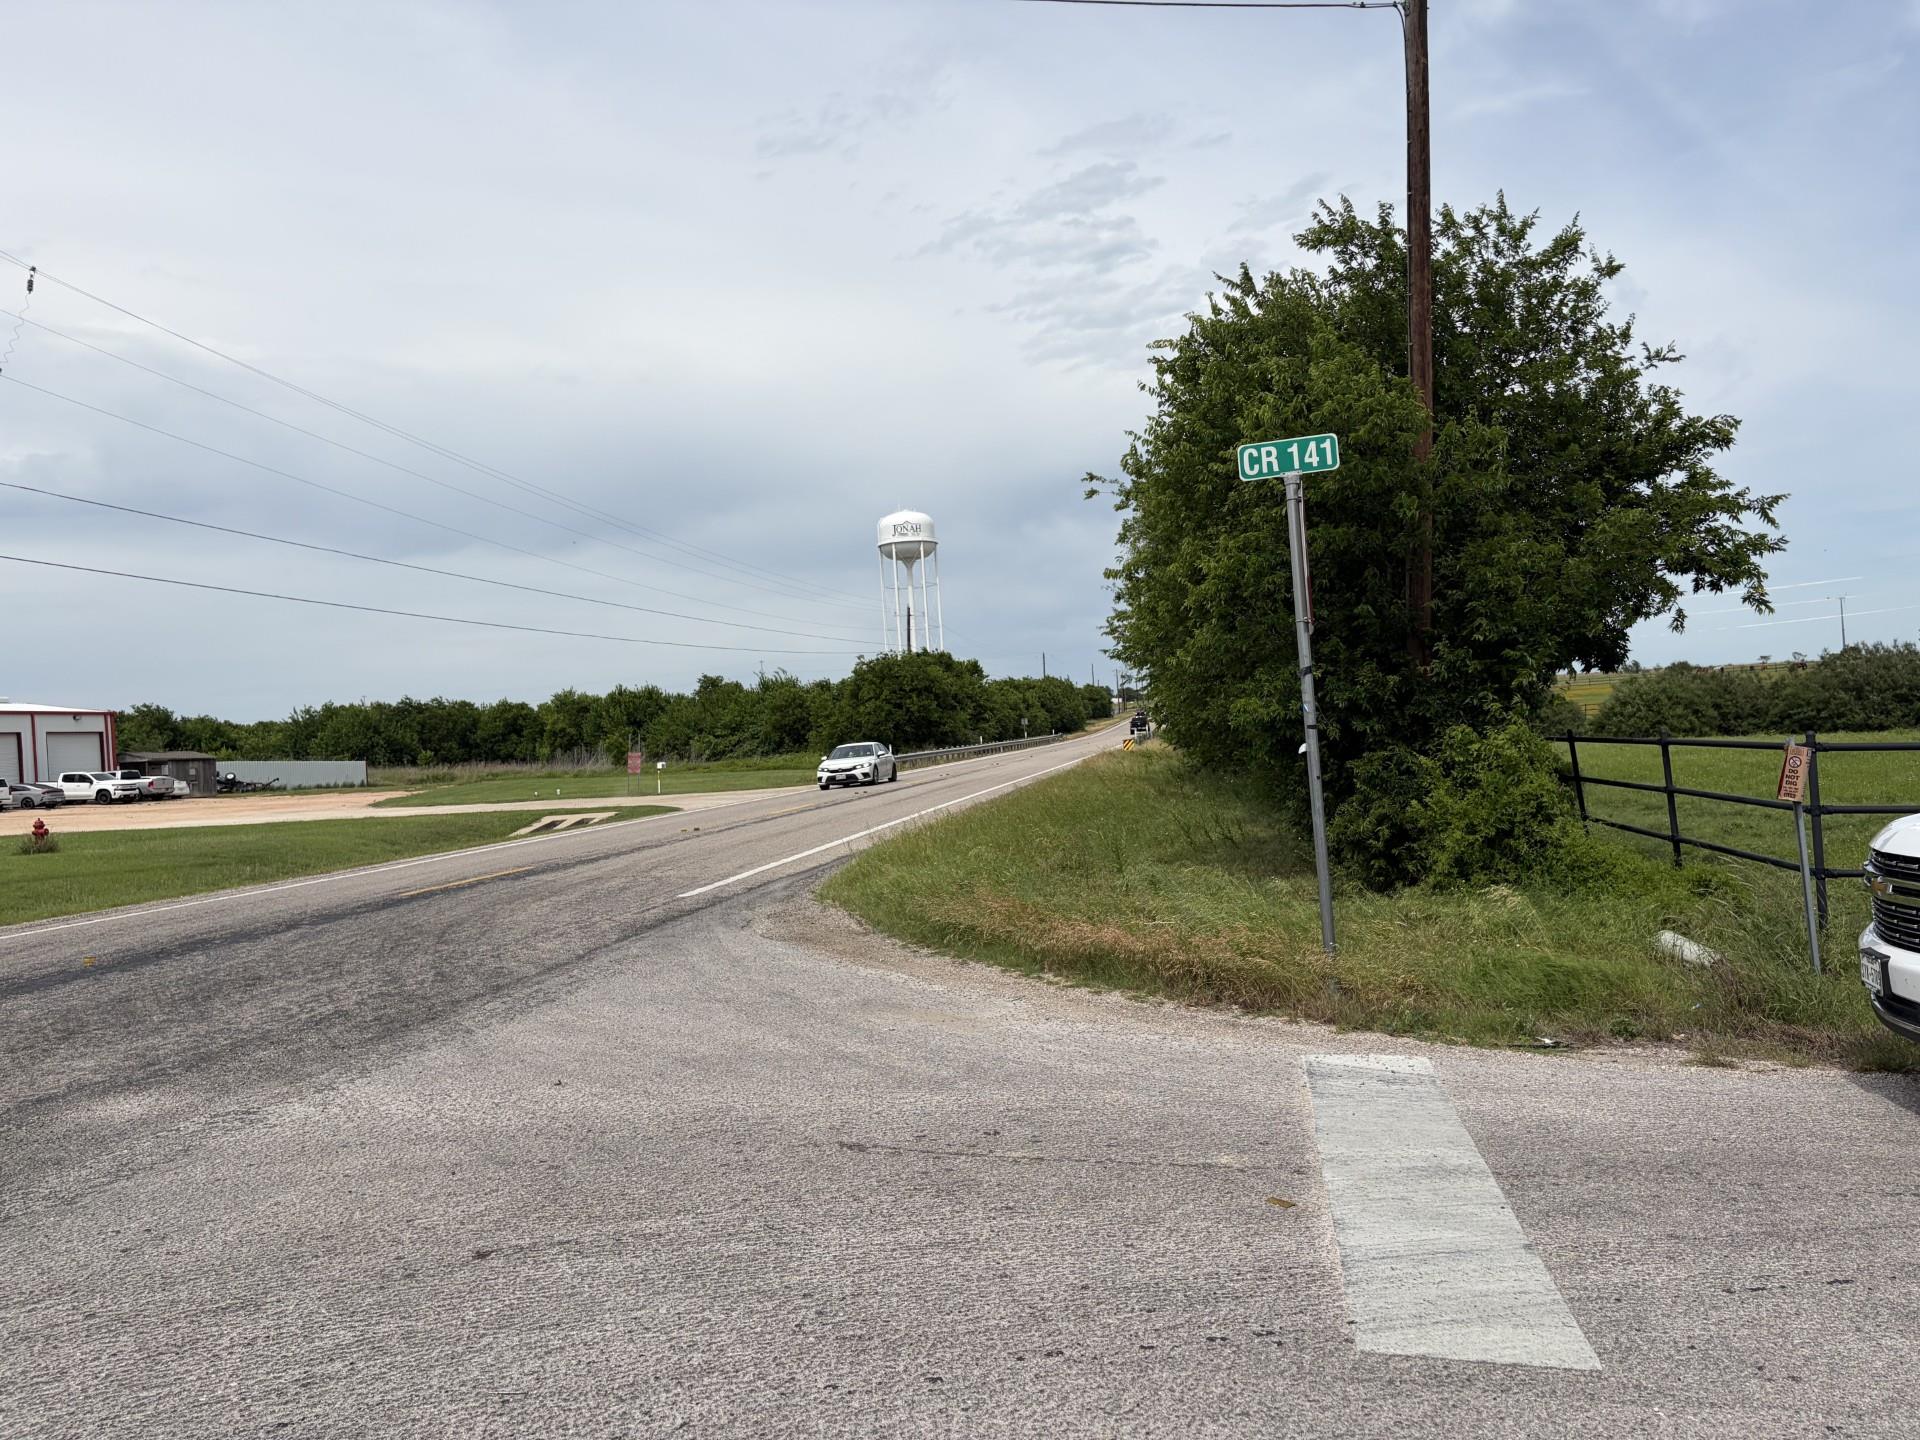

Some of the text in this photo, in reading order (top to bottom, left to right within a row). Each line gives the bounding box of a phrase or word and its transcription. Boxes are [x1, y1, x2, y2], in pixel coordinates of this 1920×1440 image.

[1243, 439, 1332, 475] CR 141
[892, 523, 921, 536] JONAH
